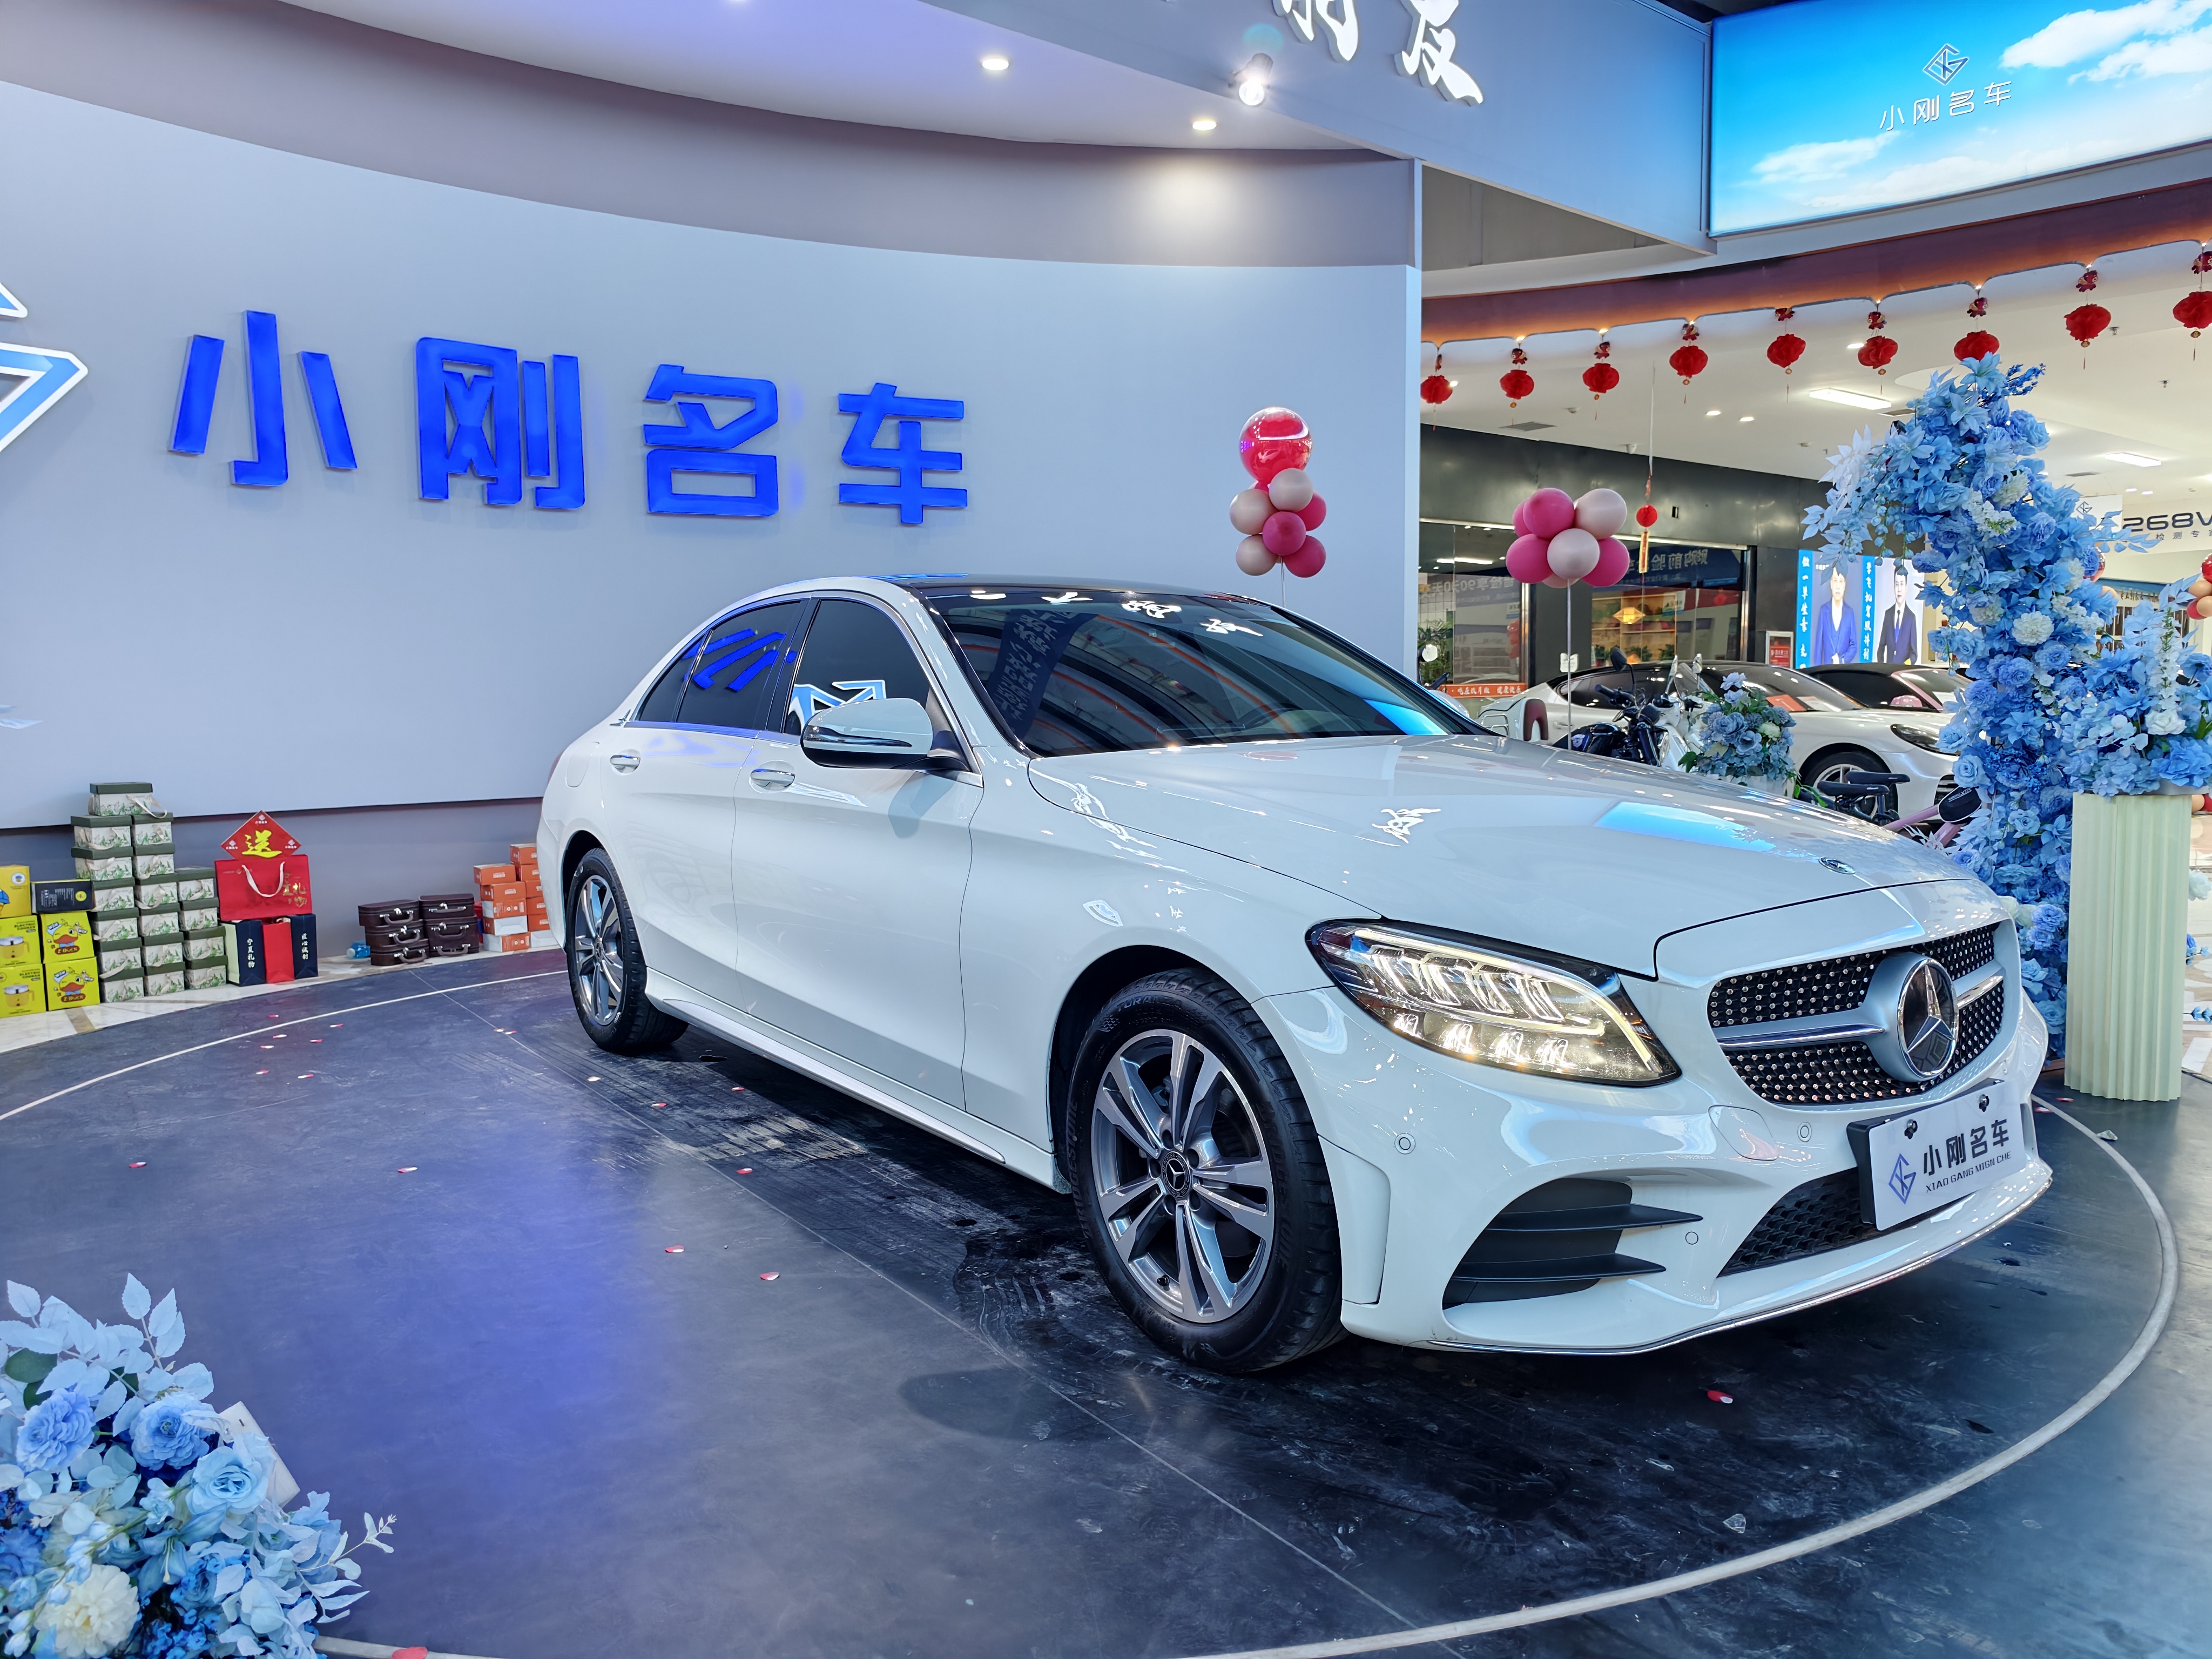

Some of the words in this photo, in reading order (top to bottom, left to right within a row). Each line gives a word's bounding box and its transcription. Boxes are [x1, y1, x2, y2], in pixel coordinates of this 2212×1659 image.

[1879, 80, 2012, 131] 小刚名车
[167, 310, 968, 526] 小刚名车
[242, 829, 283, 858] 送
[1923, 1118, 2009, 1176] 小刚名车
[1925, 1177, 1948, 1193] XIAO
[1951, 1167, 1974, 1183] GANG
[1975, 1158, 1995, 1173] MIGN
[1997, 1151, 2012, 1164] CHE
